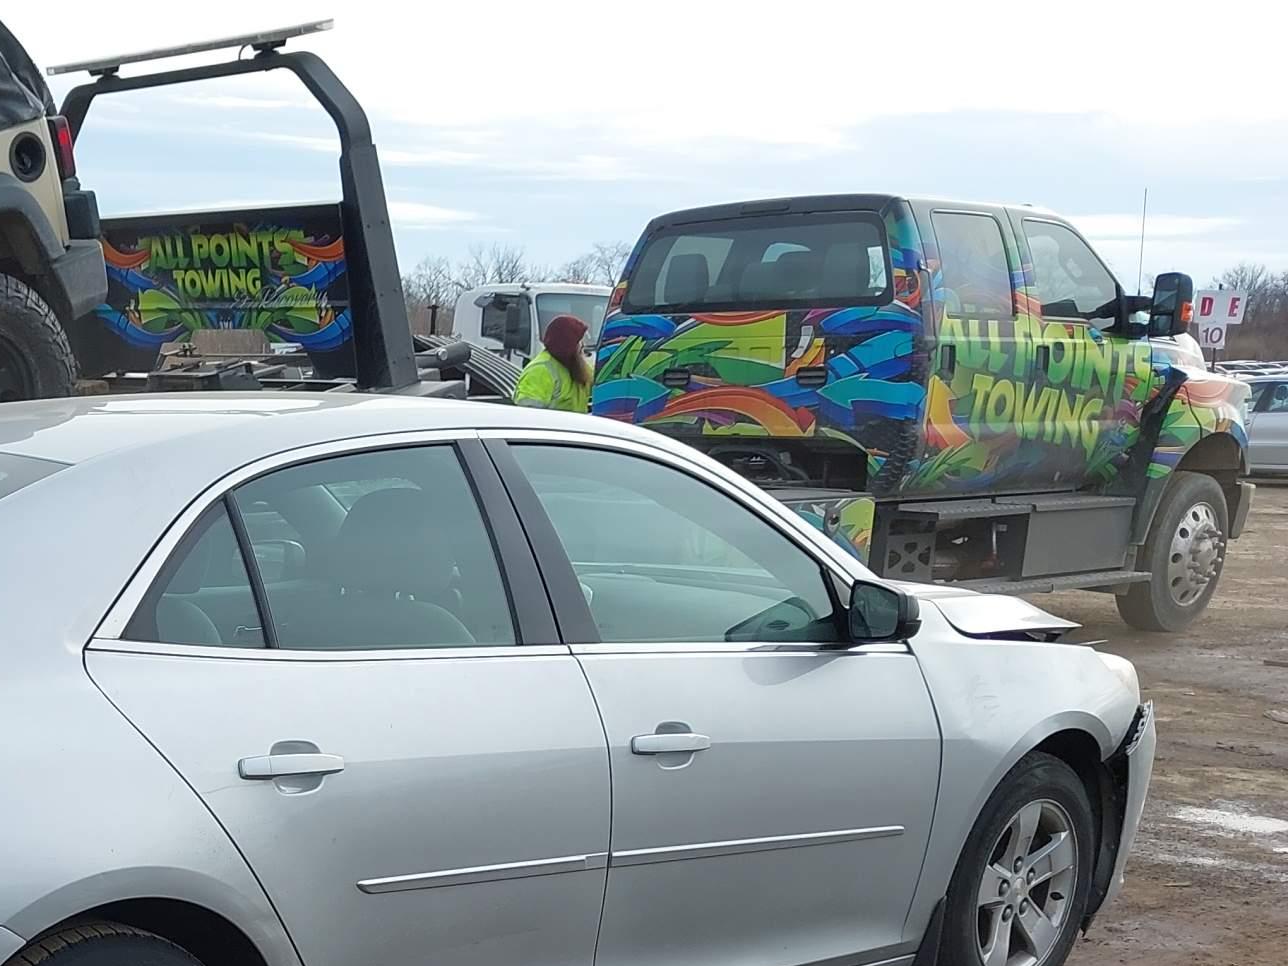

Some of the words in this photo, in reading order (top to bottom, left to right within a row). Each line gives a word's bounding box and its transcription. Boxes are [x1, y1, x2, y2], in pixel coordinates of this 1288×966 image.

[149, 234, 190, 270] ALL
[191, 230, 297, 268] POINTS
[173, 268, 261, 299] TOWING
[1200, 296, 1214, 316] D
[1228, 297, 1241, 317] E
[1202, 327, 1223, 344] 10
[936, 303, 1009, 374] ALL
[1014, 313, 1157, 408] POINTS
[969, 373, 1104, 462] TOWING
